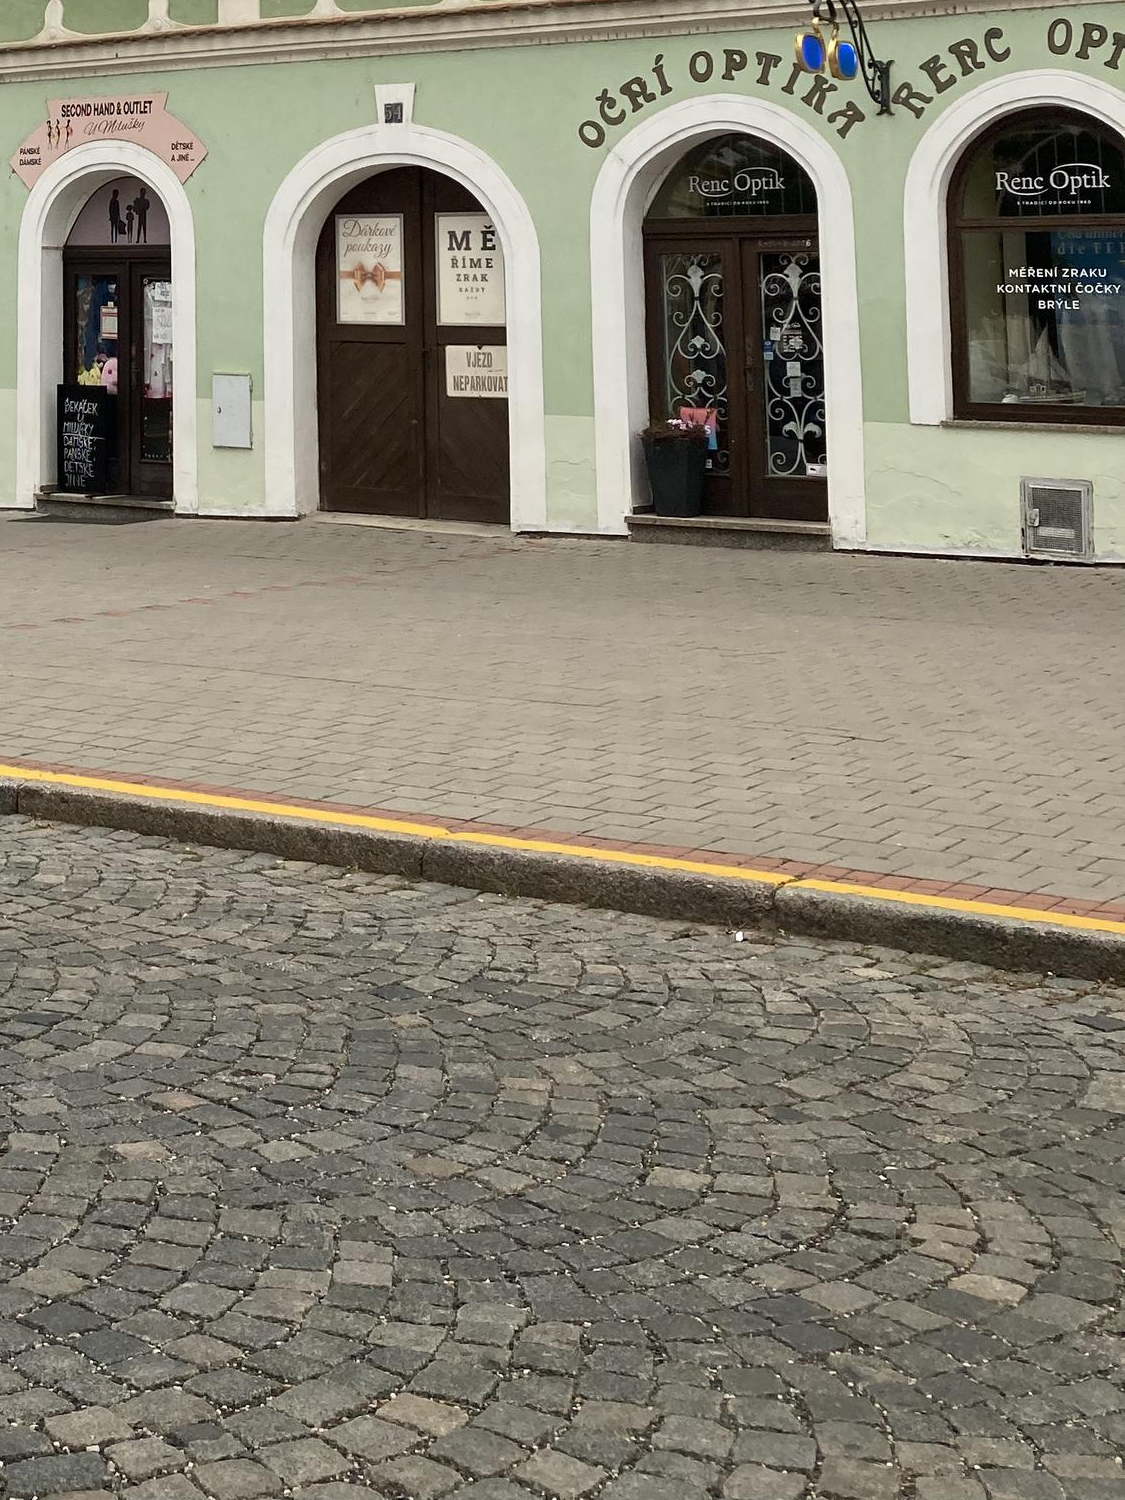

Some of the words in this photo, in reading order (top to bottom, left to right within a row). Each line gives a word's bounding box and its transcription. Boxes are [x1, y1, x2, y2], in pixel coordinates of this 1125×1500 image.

[891, 27, 1011, 119] RENC
[578, 53, 672, 148] OČNÍ
[689, 48, 866, 139] OPTIKA
[61, 104, 92, 118] SECOND
[93, 102, 115, 116] HAND
[116, 103, 122, 115] &
[123, 100, 153, 115] OUTLET
[97, 117, 145, 134] Milušky
[170, 154, 176, 162] A
[688, 175, 734, 197] Renc
[734, 166, 786, 196] Optik
[995, 171, 1049, 196] Renc
[1049, 163, 1111, 195] Optik
[342, 219, 397, 238] Dárkové
[344, 237, 393, 259] poukazy
[456, 273, 489, 282] ZRAK
[1009, 266, 1058, 278] MĚŘENÍ
[1061, 268, 1107, 278] ZRAKU
[996, 282, 1071, 294] KONTAKTNÍ
[1075, 282, 1121, 294] ČOČKY
[1038, 298, 1080, 310] BRÝLE
[466, 351, 493, 368] VJEZD
